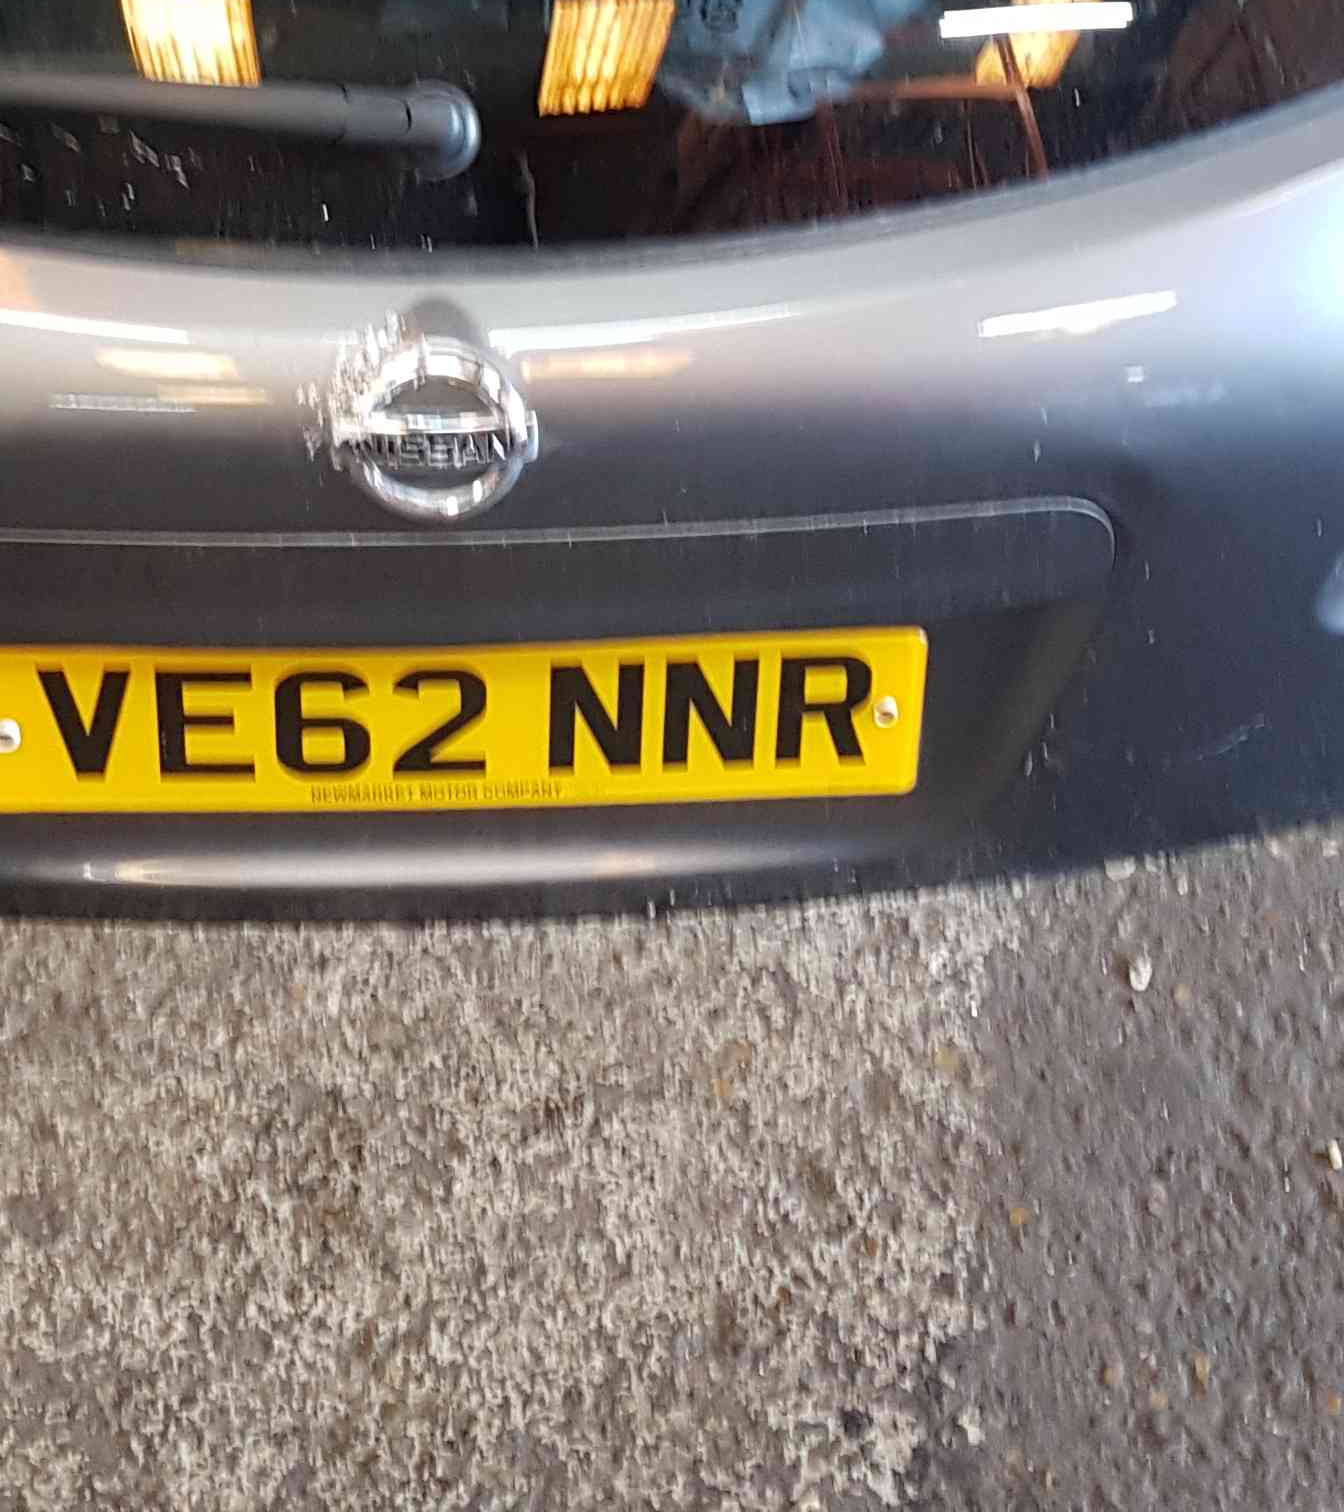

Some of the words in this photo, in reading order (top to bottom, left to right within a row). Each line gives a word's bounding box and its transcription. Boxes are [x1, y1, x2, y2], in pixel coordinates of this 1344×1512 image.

[356, 433, 508, 470] NISSAN
[36, 662, 488, 779] VE62
[546, 657, 875, 774] NNR
[419, 782, 479, 801] MOTOR
[482, 779, 563, 800] COMPANY
